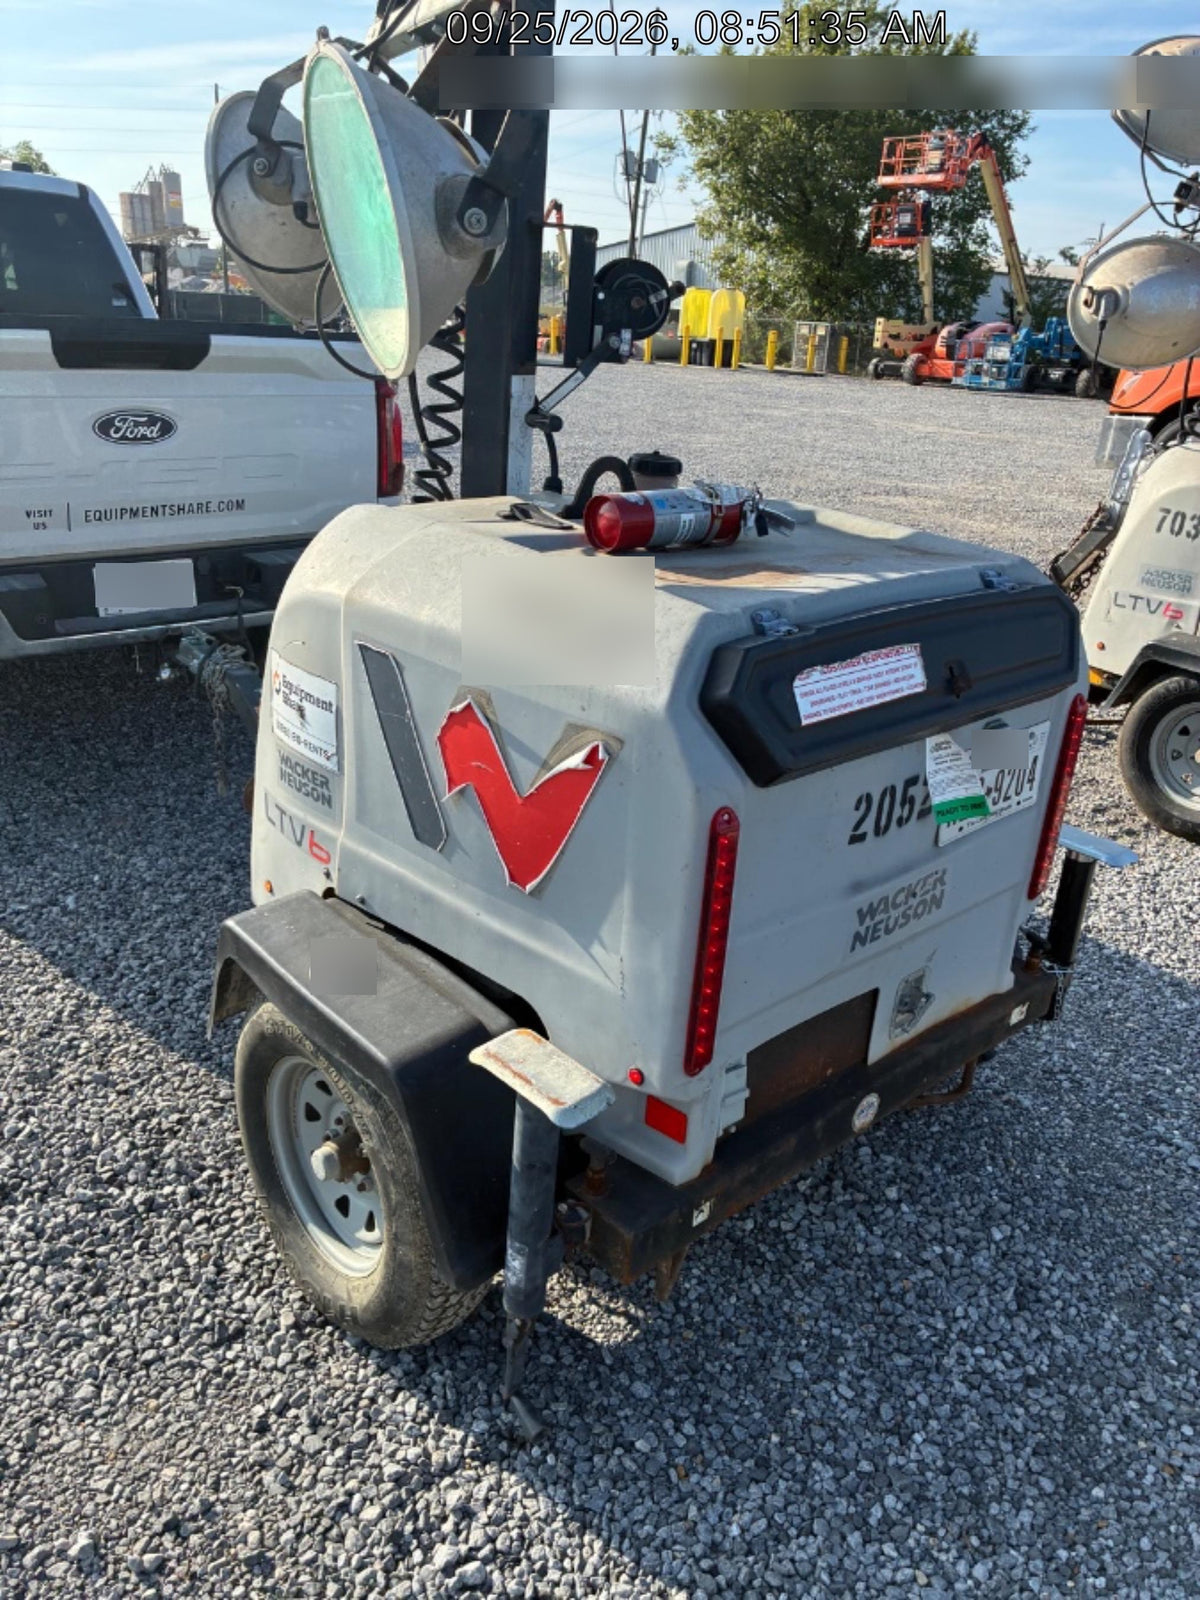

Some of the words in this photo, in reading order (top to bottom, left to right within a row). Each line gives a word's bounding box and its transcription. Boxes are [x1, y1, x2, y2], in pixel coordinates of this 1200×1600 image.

[110, 415, 161, 439] Ford
[25, 509, 53, 519] VISIT
[84, 498, 246, 523] EQUIPMENTSHARE.COM
[33, 521, 48, 530] US
[281, 673, 334, 714] Equipment
[278, 749, 332, 794] WACKER
[279, 766, 333, 809] NEUSON
[856, 867, 948, 927] WACKER
[850, 888, 945, 953] NEUSON
